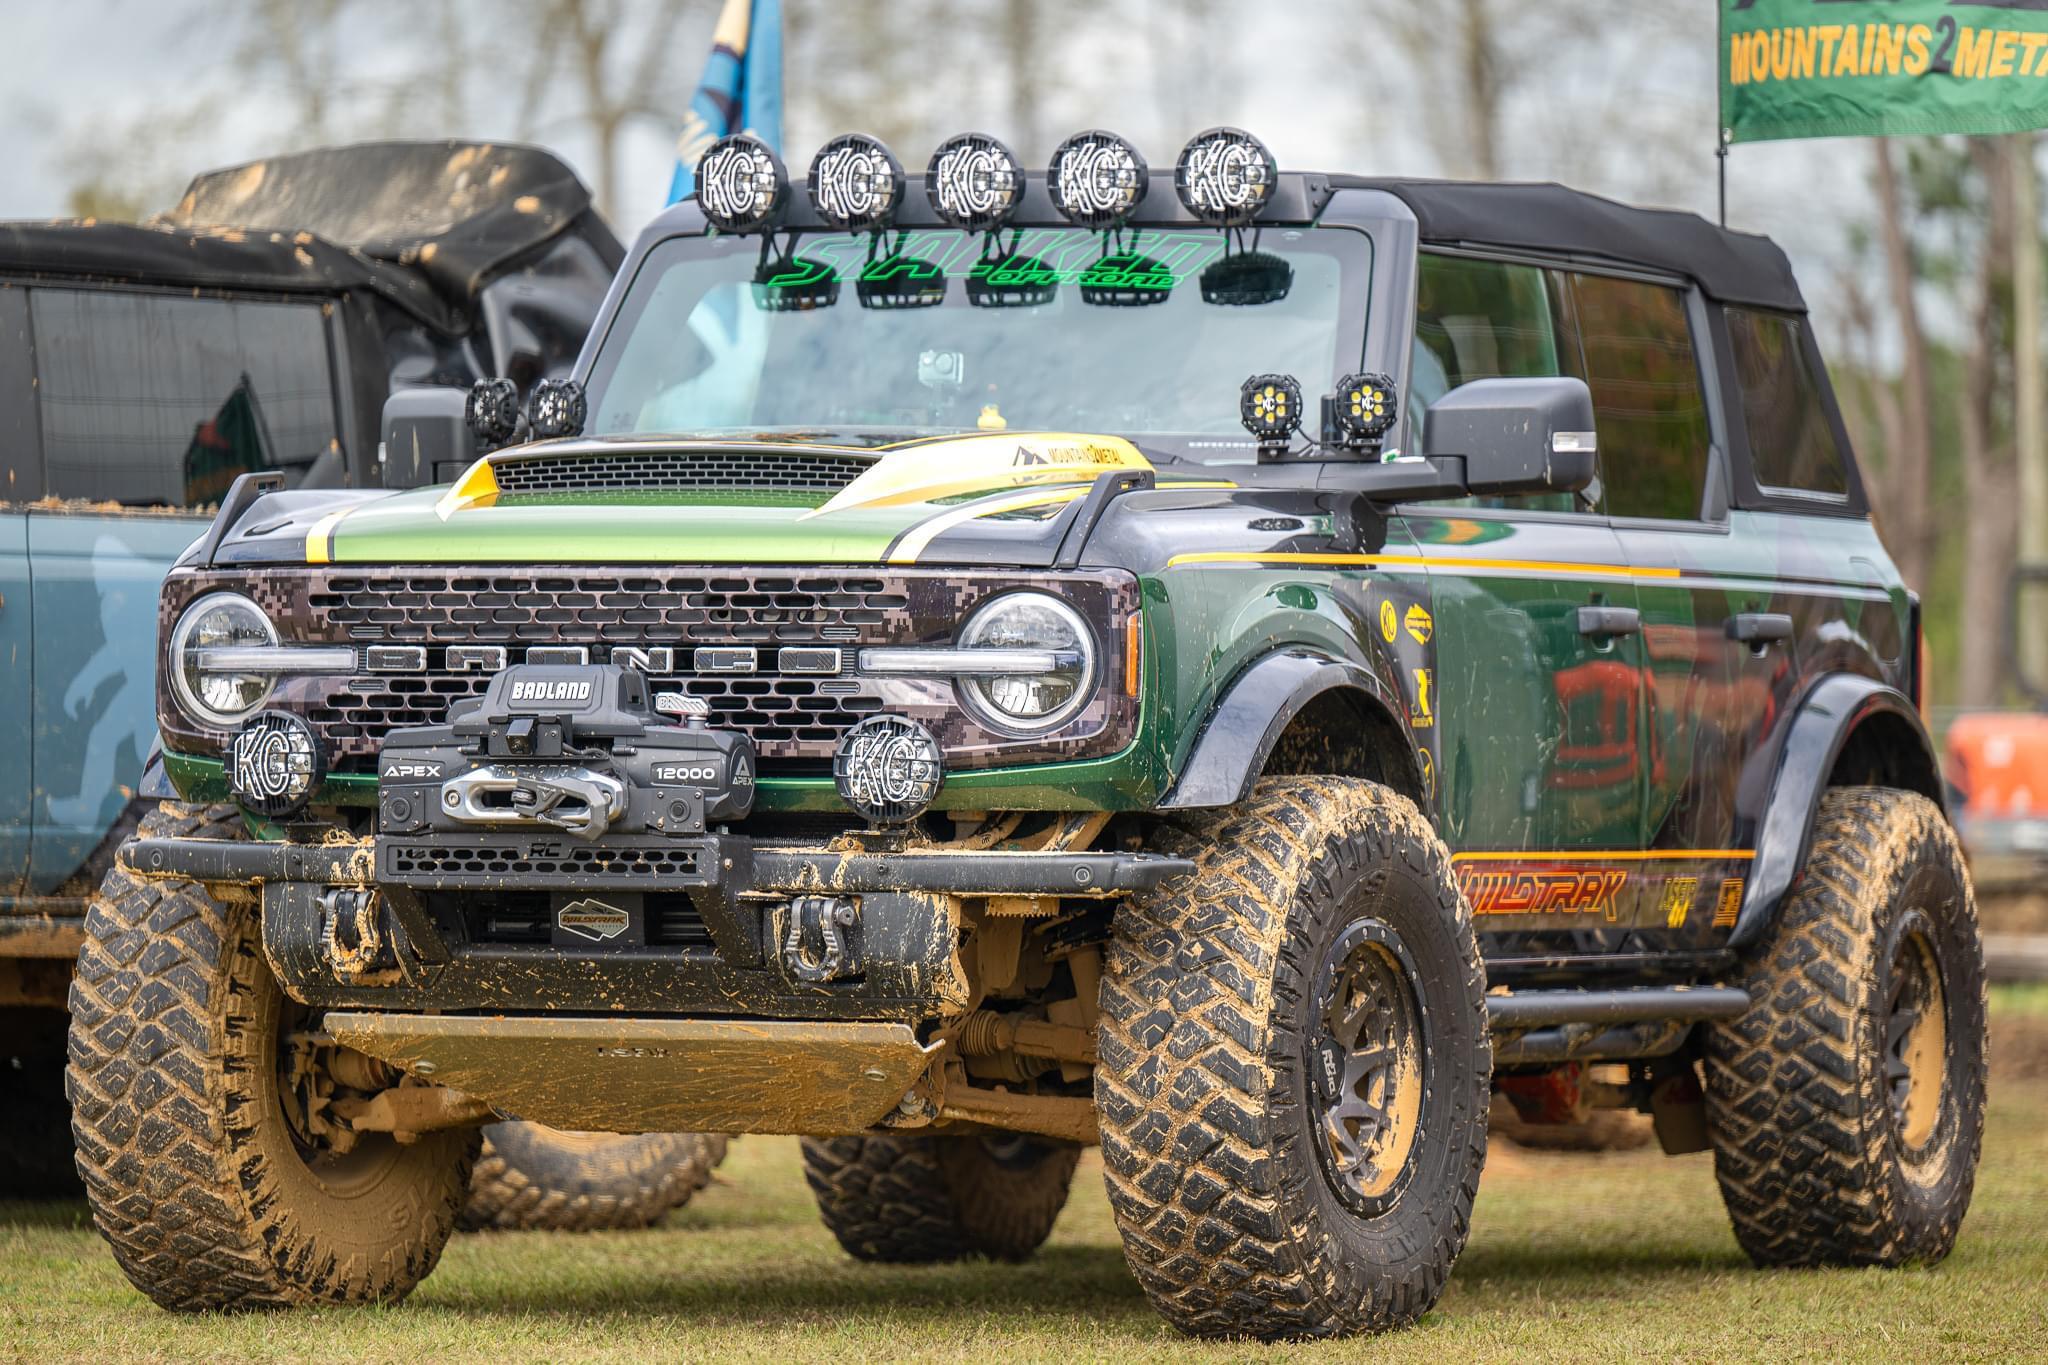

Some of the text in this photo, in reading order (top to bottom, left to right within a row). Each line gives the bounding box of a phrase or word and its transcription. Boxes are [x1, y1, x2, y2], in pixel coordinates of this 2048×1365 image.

[702, 147, 756, 218] KC
[818, 147, 873, 219] KC
[937, 145, 995, 217] KC
[1060, 142, 1118, 215] KC
[1188, 139, 1250, 211] KC
[986, 270, 1185, 290] OFFROAD
[1262, 398, 1275, 412] KC
[1361, 397, 1374, 410] KC
[366, 645, 842, 674] BRONCO
[511, 681, 591, 700] BADLAND
[234, 724, 290, 800] KC
[384, 765, 441, 777] APEX
[656, 767, 716, 780] 12000
[850, 729, 917, 806] KC
[732, 775, 752, 786] APEX
[529, 842, 562, 857] RC
